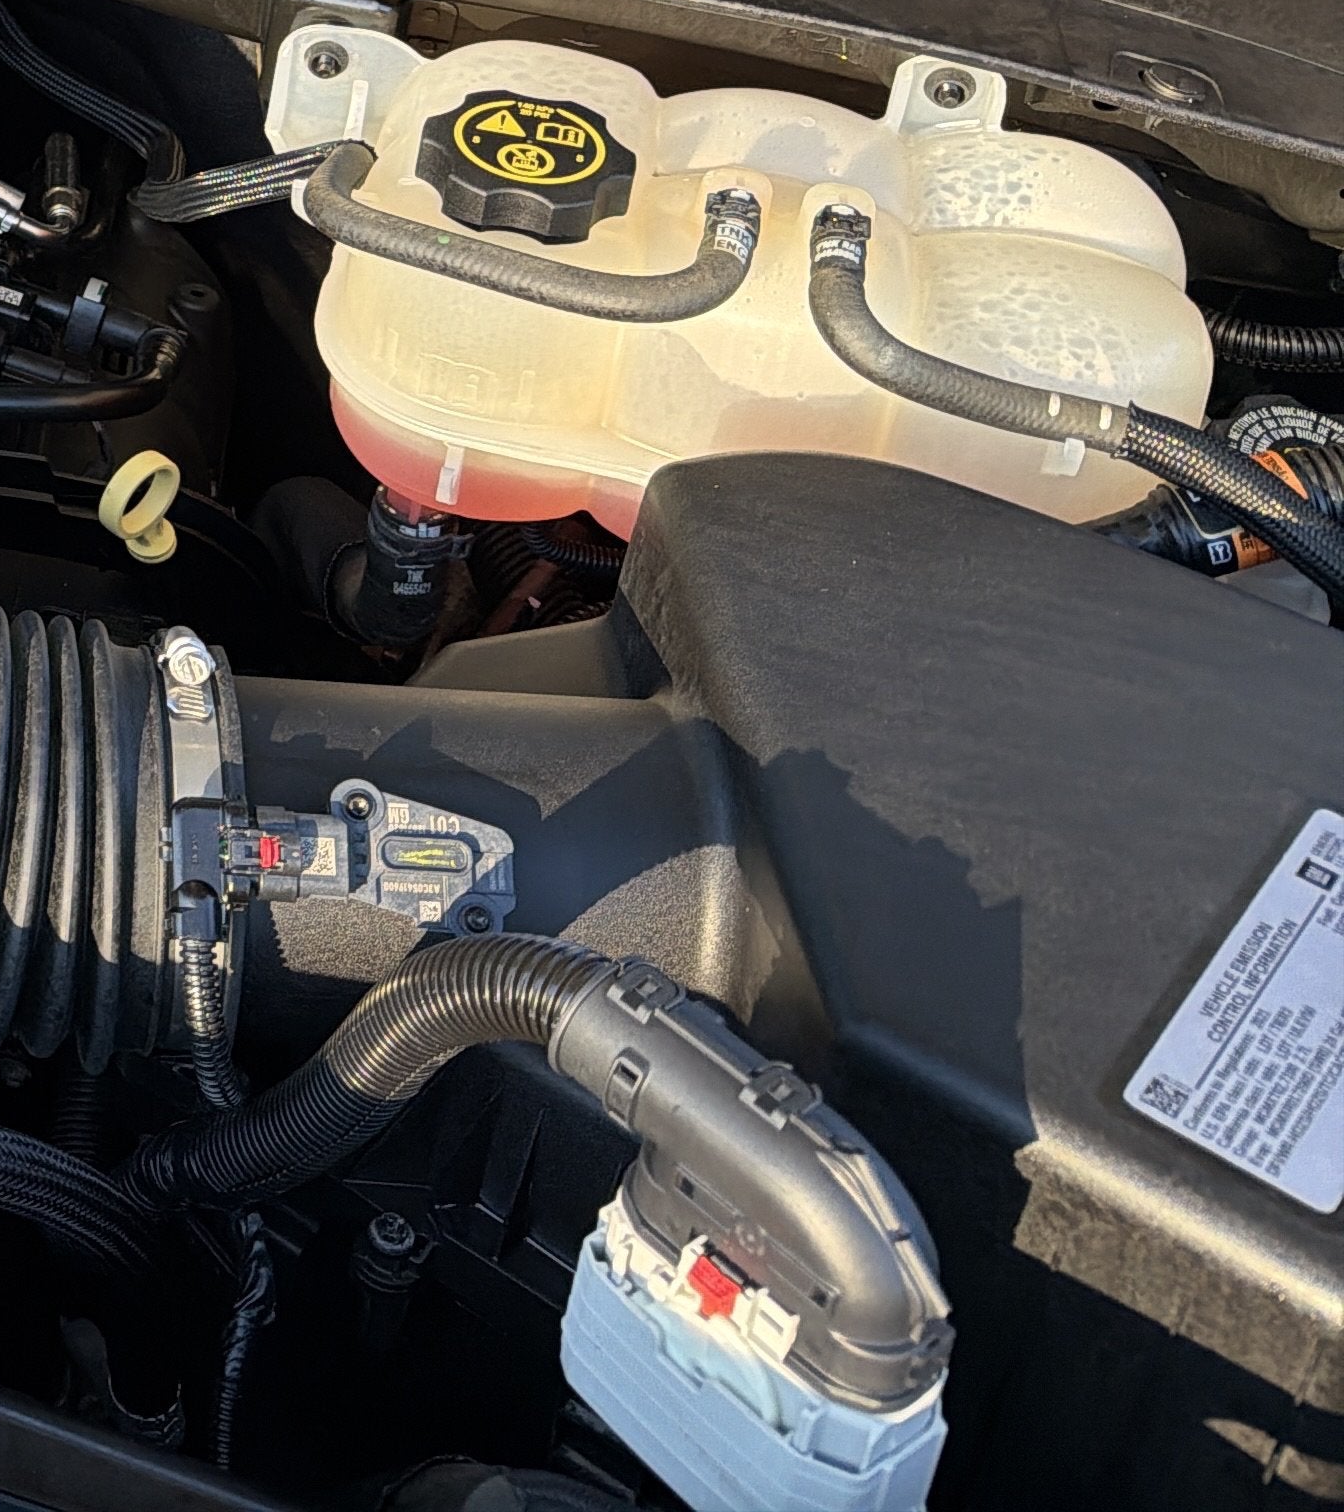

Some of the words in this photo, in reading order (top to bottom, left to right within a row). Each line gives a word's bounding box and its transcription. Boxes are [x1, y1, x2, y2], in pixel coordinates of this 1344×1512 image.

[1271, 406, 1317, 421] BOUCHON
[1319, 416, 1344, 434] AVAN
[1277, 417, 1314, 431] LIQUIDE
[1295, 428, 1327, 446] BIDON
[387, 806, 410, 824] GM
[1199, 970, 1241, 1018] VEHICLE
[1230, 921, 1273, 974] EMISSION
[1206, 991, 1253, 1043] CONTROL
[1241, 918, 1298, 991] INFORMATION
